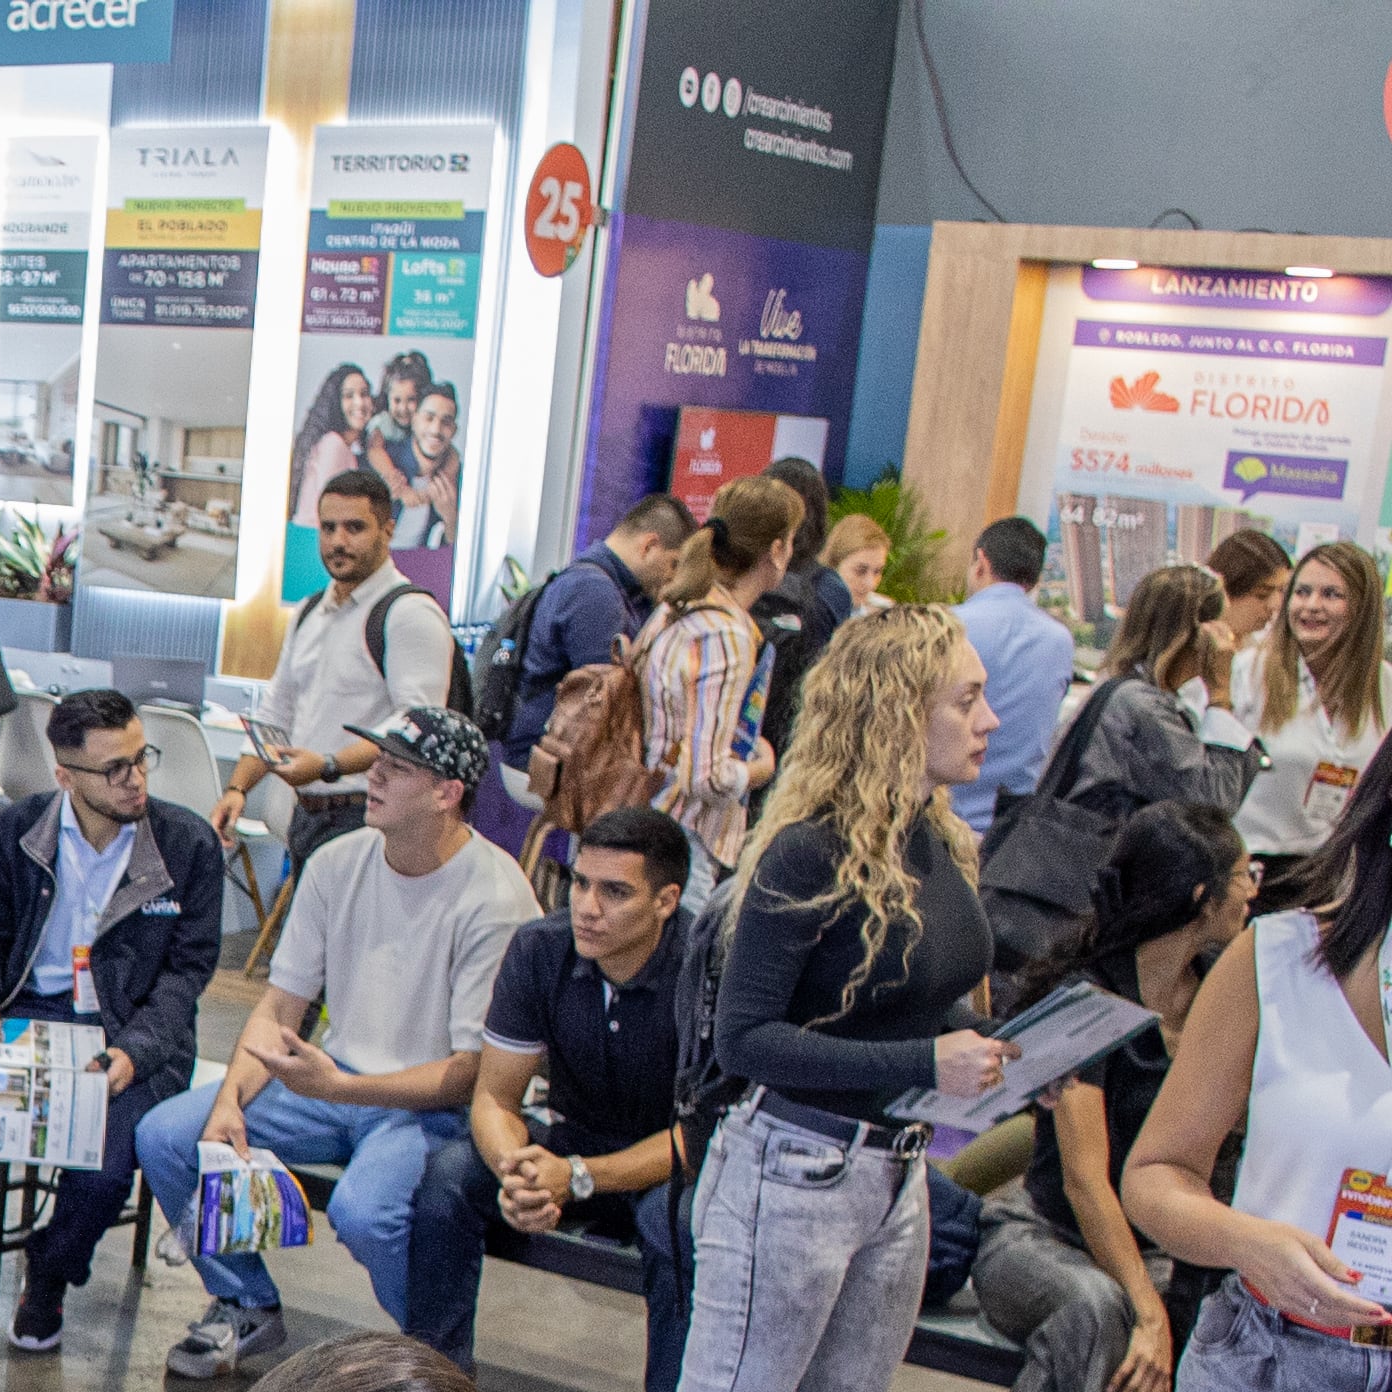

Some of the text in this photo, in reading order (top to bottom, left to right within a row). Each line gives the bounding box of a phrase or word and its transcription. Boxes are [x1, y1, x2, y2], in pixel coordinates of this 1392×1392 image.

[7, 0, 147, 32] acrecer
[137, 147, 239, 167] TRIALA
[332, 155, 446, 172] TERRITORIO
[533, 177, 583, 241] 25
[118, 254, 241, 271] APARTAMENTOS
[1150, 275, 1318, 303] LANZAMIENTO
[1292, 341, 1355, 359] FLORIDA
[1189, 389, 1330, 426] FLORIDA
[1070, 450, 1130, 473] $574
